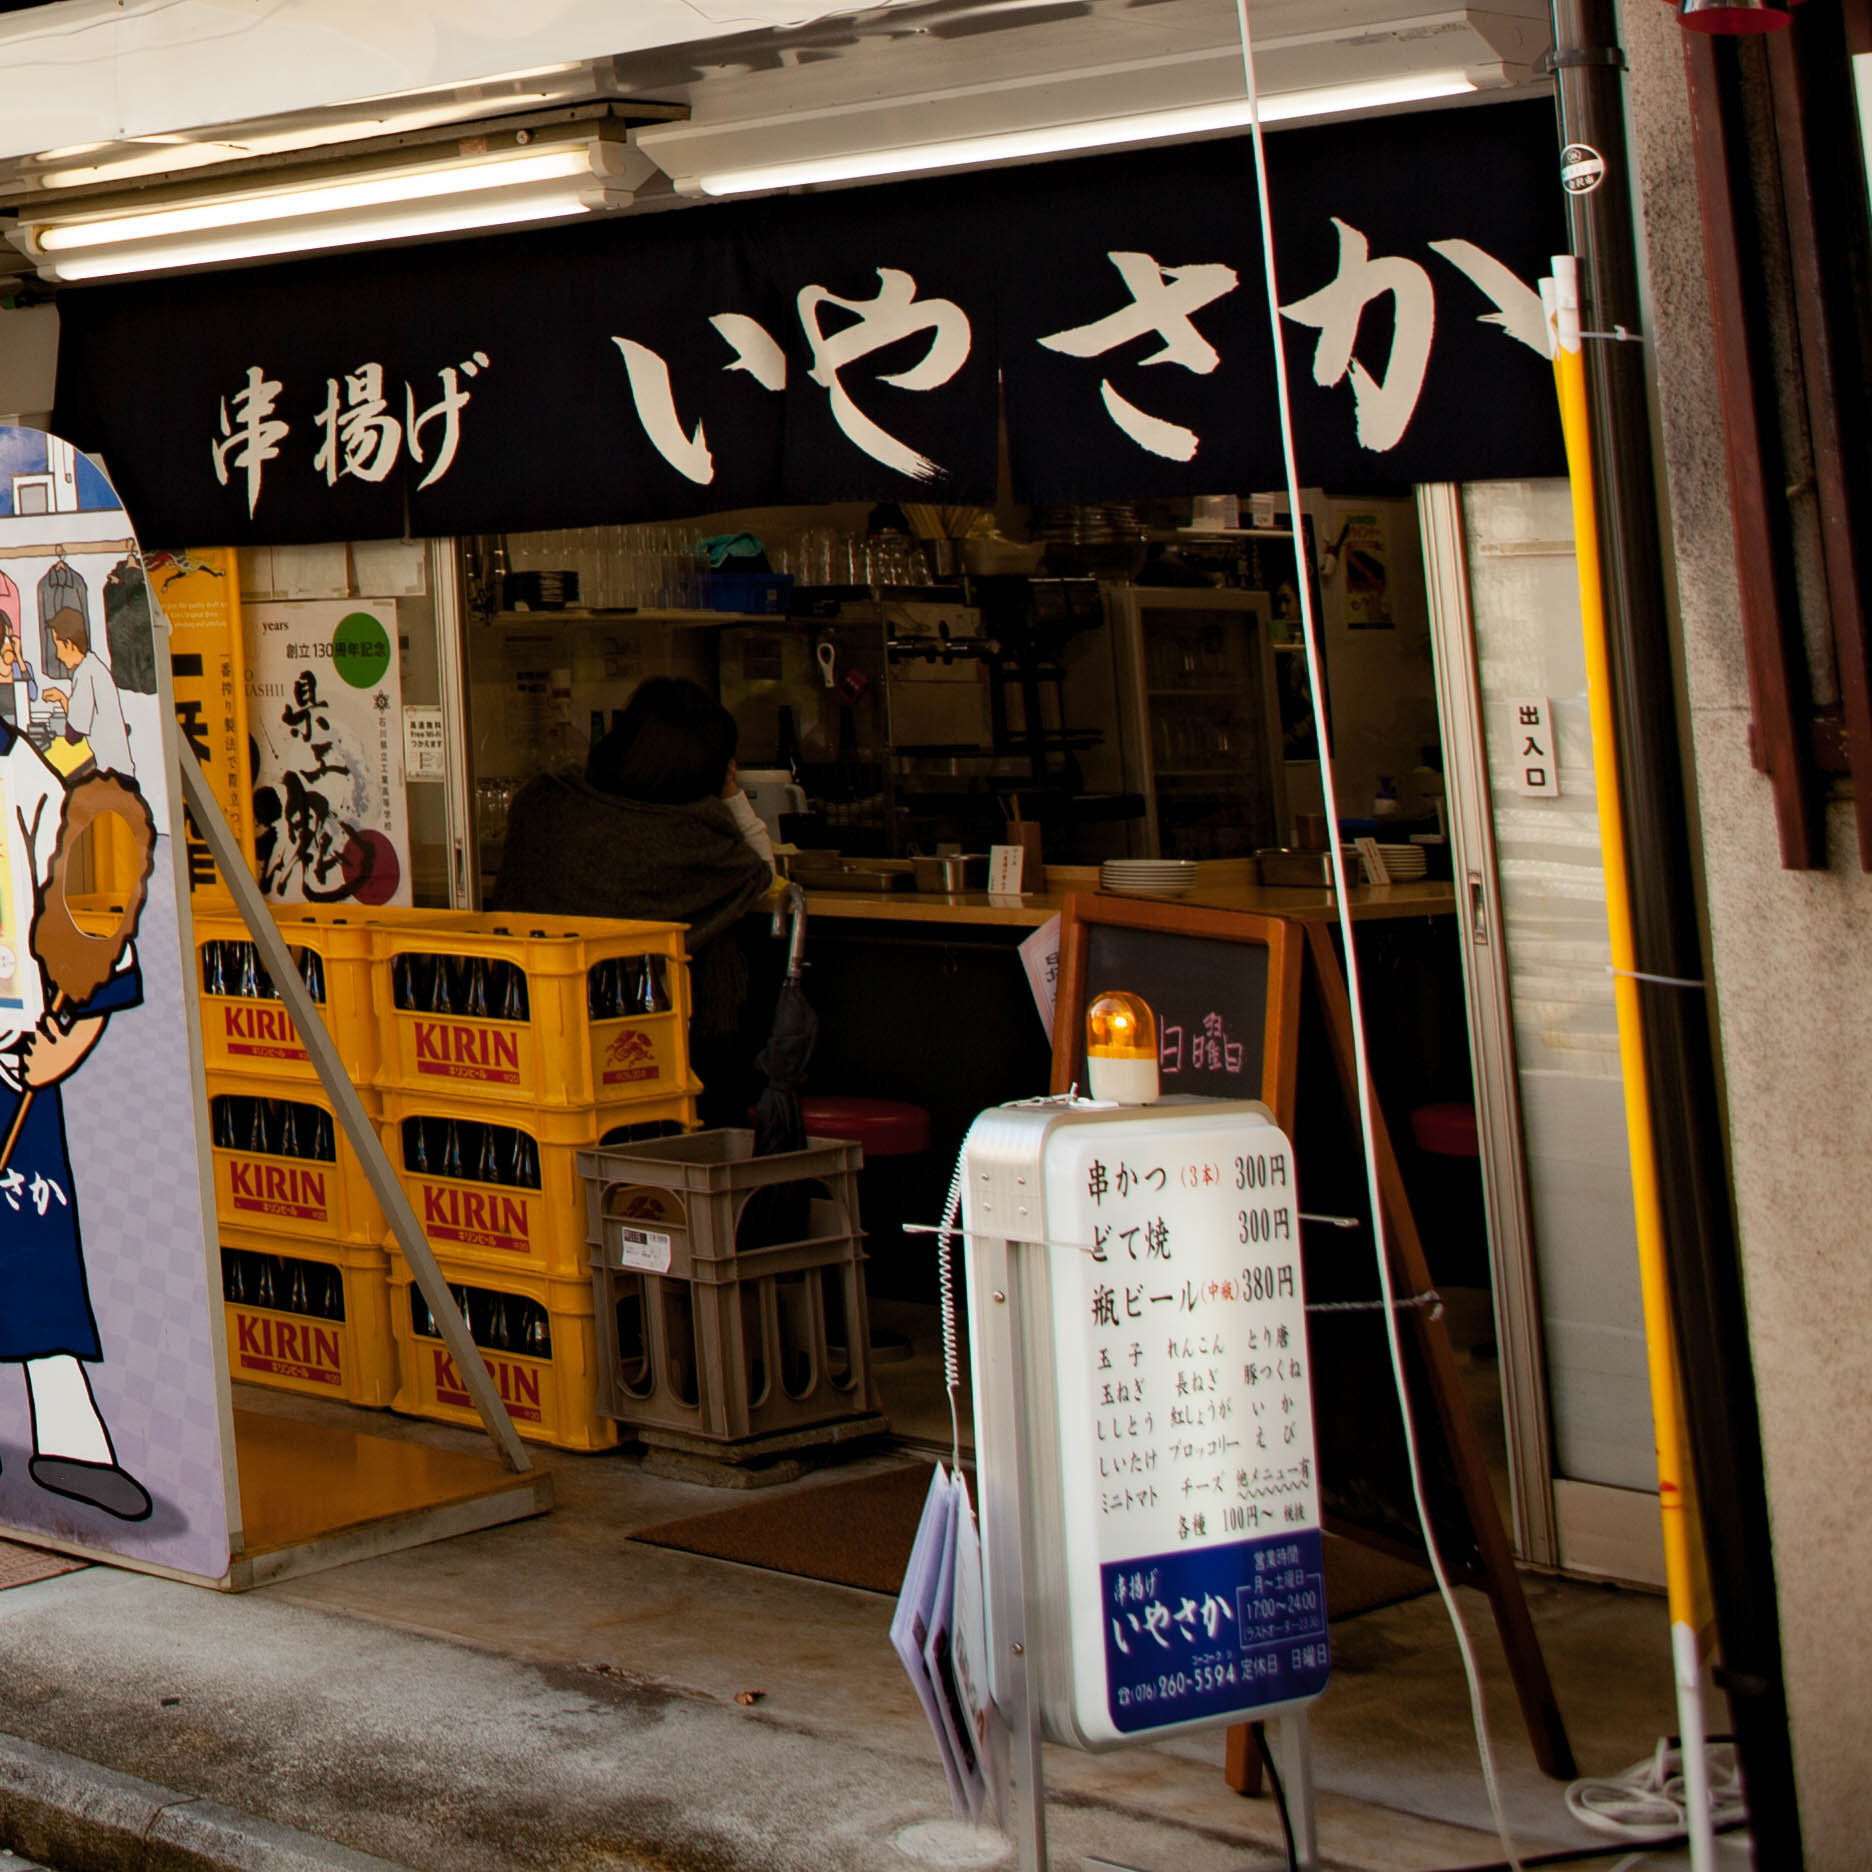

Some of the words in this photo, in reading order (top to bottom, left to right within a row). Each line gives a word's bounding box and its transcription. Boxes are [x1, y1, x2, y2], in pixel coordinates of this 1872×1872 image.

[210, 350, 491, 520] 串揚げ
[612, 216, 1556, 486] いやさか
[262, 621, 289, 635] years
[286, 642, 387, 659] 創立130周年記念
[1519, 705, 1546, 787] 出入口
[224, 1006, 296, 1043] KIRI
[414, 1022, 520, 1069] KIRIN
[230, 1160, 326, 1207] KIRIN
[1087, 1159, 1167, 1207] 串かつ
[1234, 1154, 1286, 1190] 300円
[423, 1184, 529, 1238] KIRIN
[1090, 1216, 1172, 1263] どて焼
[1238, 1207, 1290, 1245] 300円
[1091, 1280, 1199, 1326] 瓶ビール
[1242, 1264, 1294, 1303] 380円
[237, 1314, 341, 1370] KIRIN
[1167, 1333, 1225, 1360] れんこん
[1247, 1323, 1289, 1350] とり唐
[433, 1350, 540, 1407] KIN
[1100, 1377, 1145, 1406] 玉ねぎ
[1175, 1367, 1220, 1397] 長ねぎ
[1243, 1356, 1302, 1386] 豚つくね
[1096, 1411, 1155, 1441] ししとう
[1170, 1396, 1233, 1428] 紅しょうが
[1251, 1391, 1295, 1417] いか
[1099, 1447, 1159, 1478] しいたけ
[1168, 1433, 1241, 1460] ブロッコリー
[1101, 1483, 1159, 1515] ミニトマト
[1180, 1469, 1225, 1499] チーズ
[1178, 1511, 1207, 1541] 各種
[1113, 1568, 1160, 1608] 串揚げ
[1111, 1591, 1235, 1656] いやさか
[1158, 1662, 1238, 1698] 260-5594
[1240, 1653, 1279, 1680] 定休日
[1291, 1643, 1329, 1670] 日曜日
